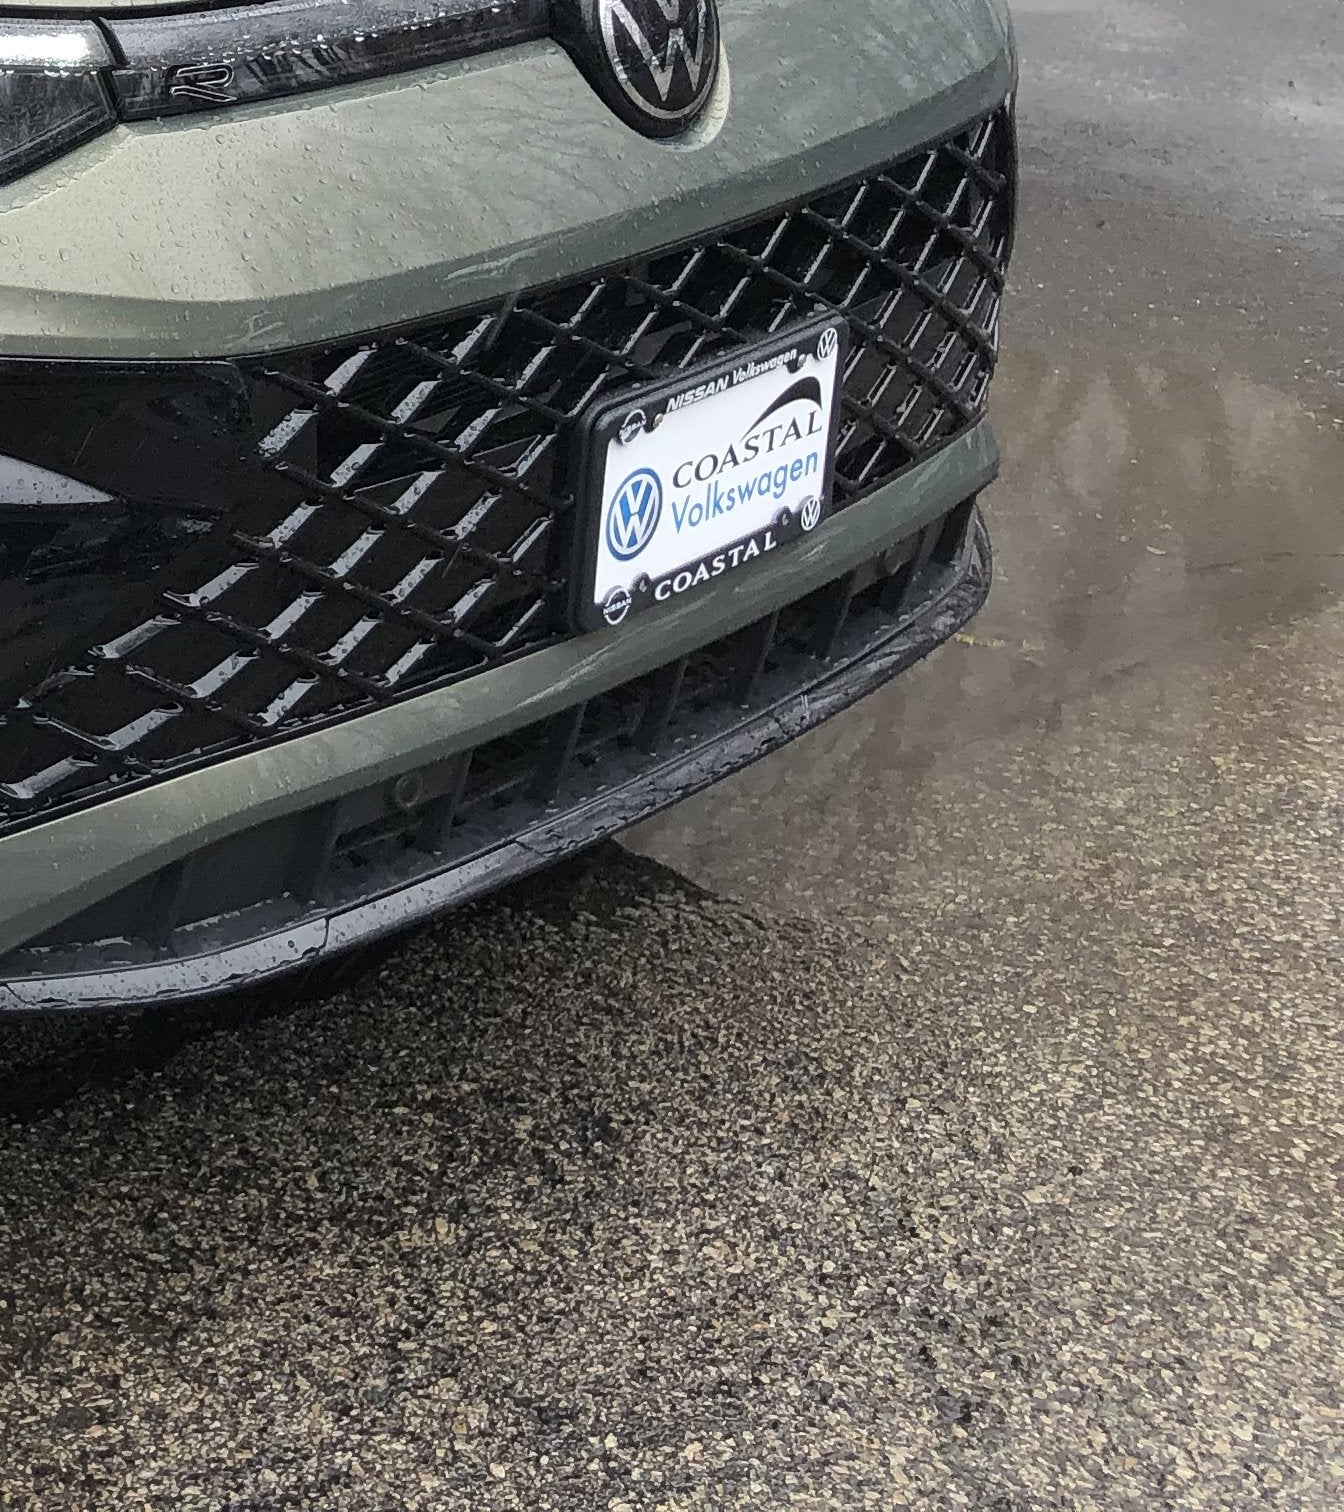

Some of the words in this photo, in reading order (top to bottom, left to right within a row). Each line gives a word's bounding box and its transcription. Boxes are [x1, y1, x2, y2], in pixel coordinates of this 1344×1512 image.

[666, 375, 729, 412] NISSAN
[732, 348, 798, 385] Volkswagen
[672, 410, 823, 489] COASTAL
[671, 451, 819, 534] Volkswagen
[654, 531, 777, 601] COASTAL
